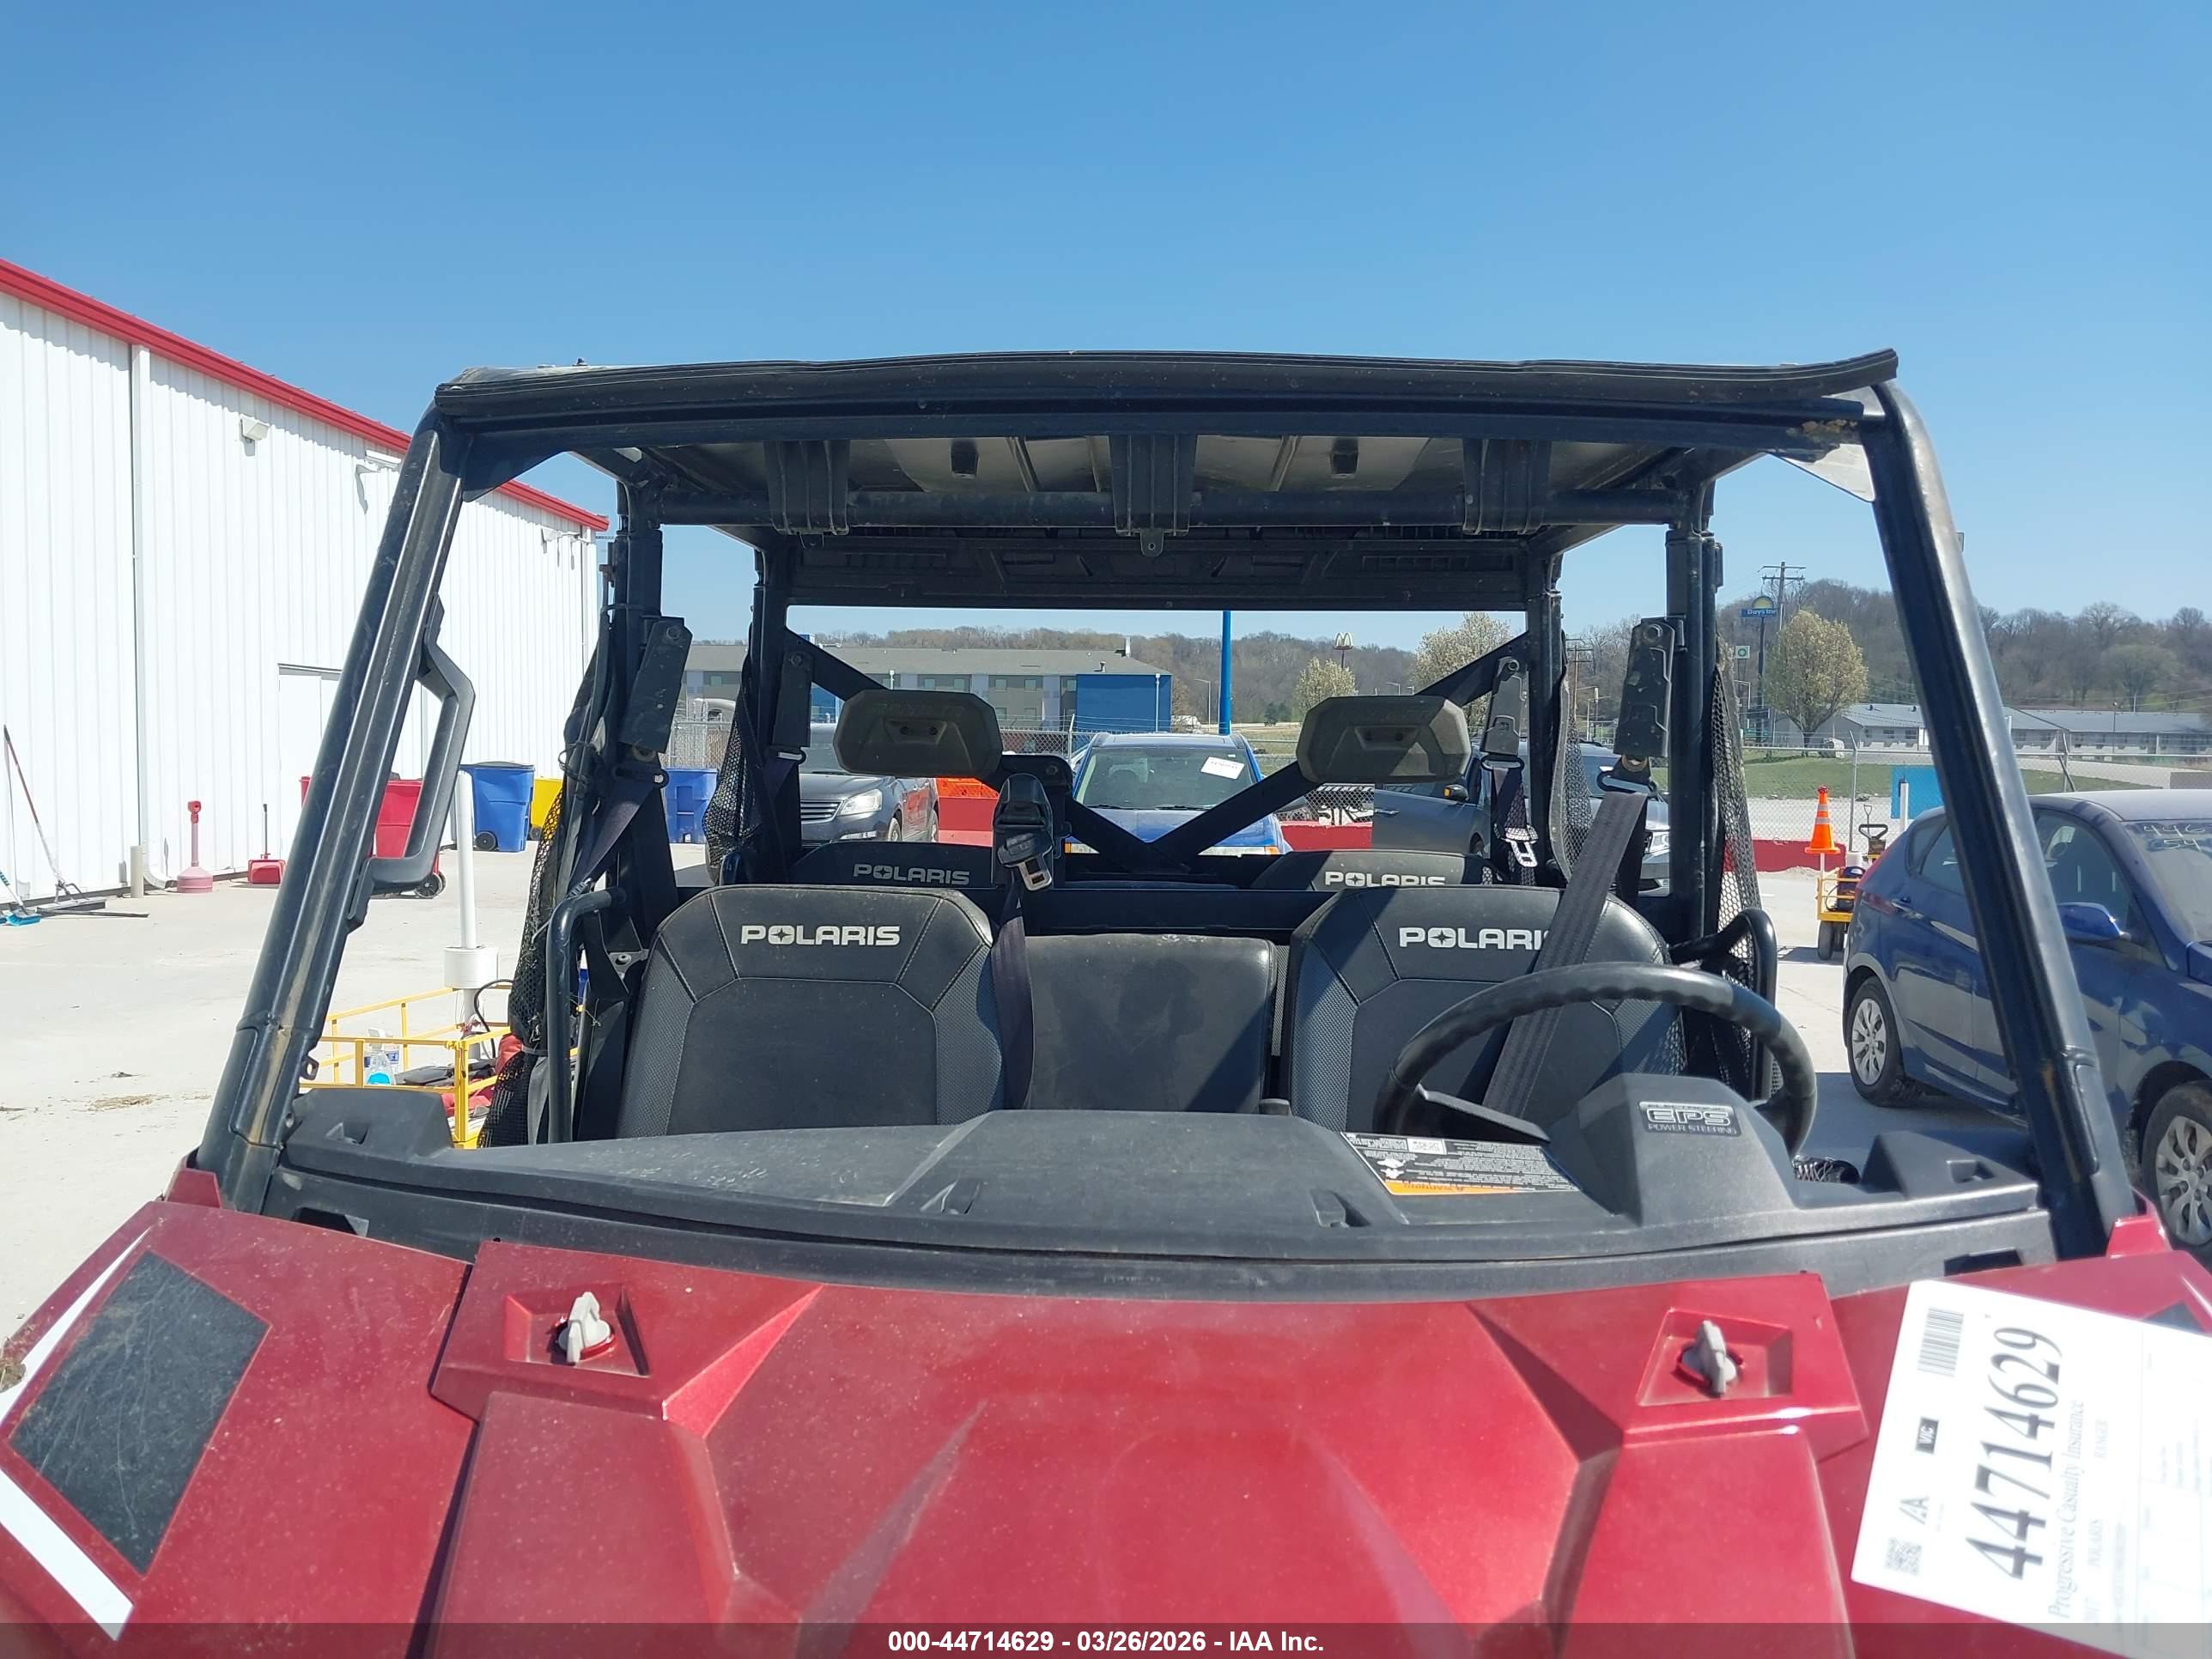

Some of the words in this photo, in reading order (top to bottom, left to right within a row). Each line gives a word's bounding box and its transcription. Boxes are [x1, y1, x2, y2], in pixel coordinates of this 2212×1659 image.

[853, 863, 970, 886] POLARIS
[740, 924, 901, 946] POLARIS
[1399, 927, 1549, 951] POLARI
[1647, 1108, 1730, 1126] EPS
[1648, 1123, 1686, 1133] POWER
[1687, 1125, 1737, 1134] STEERING
[2061, 1399, 2085, 1460] Insurance
[1965, 1327, 2063, 1581] 44714629
[2056, 1462, 2085, 1523] Casualty
[2047, 1527, 2078, 1620] Progressive
